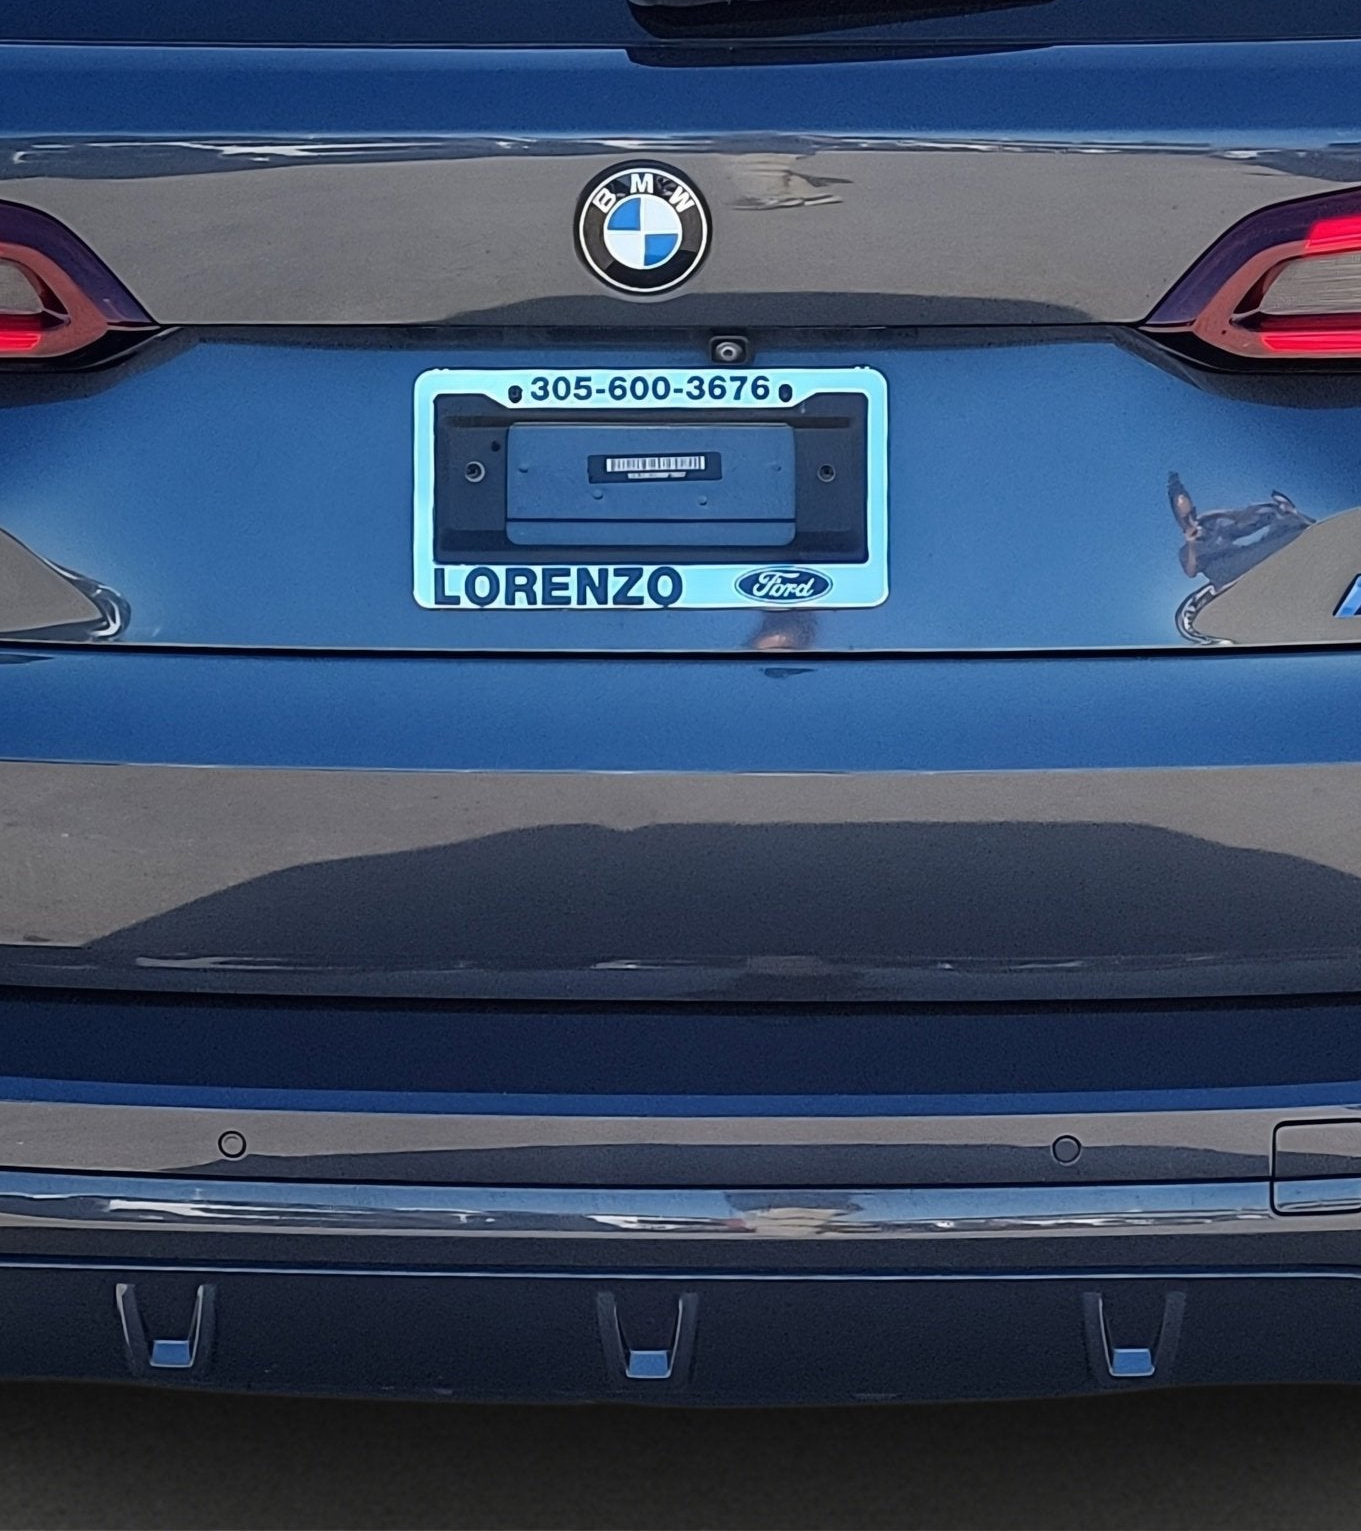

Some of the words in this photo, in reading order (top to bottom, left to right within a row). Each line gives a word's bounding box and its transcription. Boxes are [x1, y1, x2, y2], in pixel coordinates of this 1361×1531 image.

[592, 173, 696, 214] BMW
[530, 376, 771, 402] 305-600-3676
[433, 567, 683, 607] LORENZO
[752, 571, 815, 600] Ford
